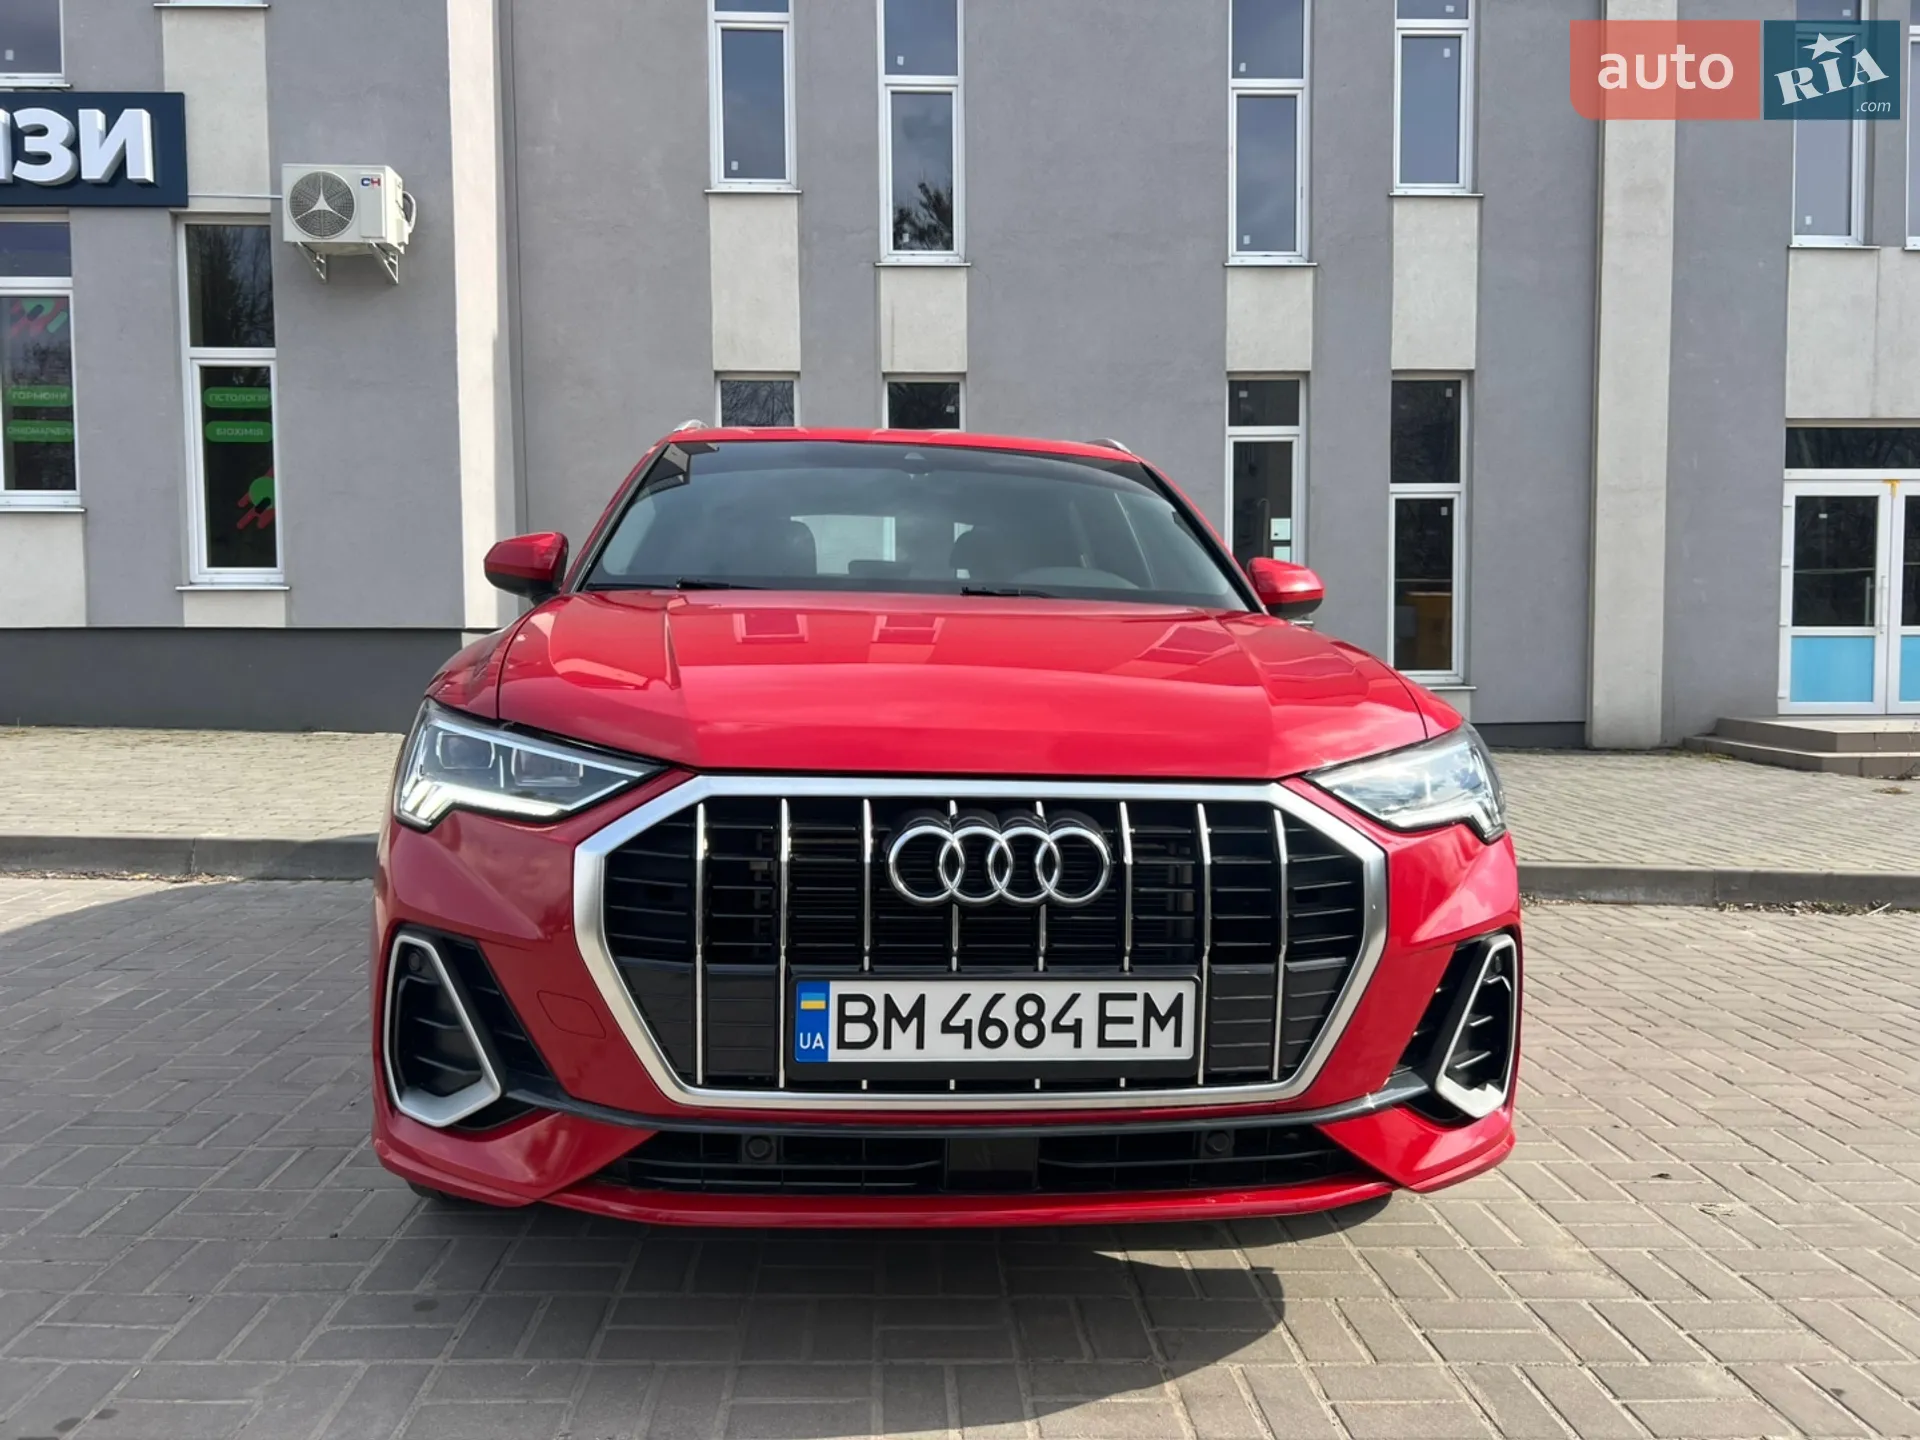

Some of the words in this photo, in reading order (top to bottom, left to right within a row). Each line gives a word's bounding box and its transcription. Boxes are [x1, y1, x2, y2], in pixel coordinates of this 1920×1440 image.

[836, 993, 926, 1051] BM
[940, 993, 1082, 1050] 4684
[1097, 992, 1184, 1049] EM
[800, 1032, 825, 1050] UA
